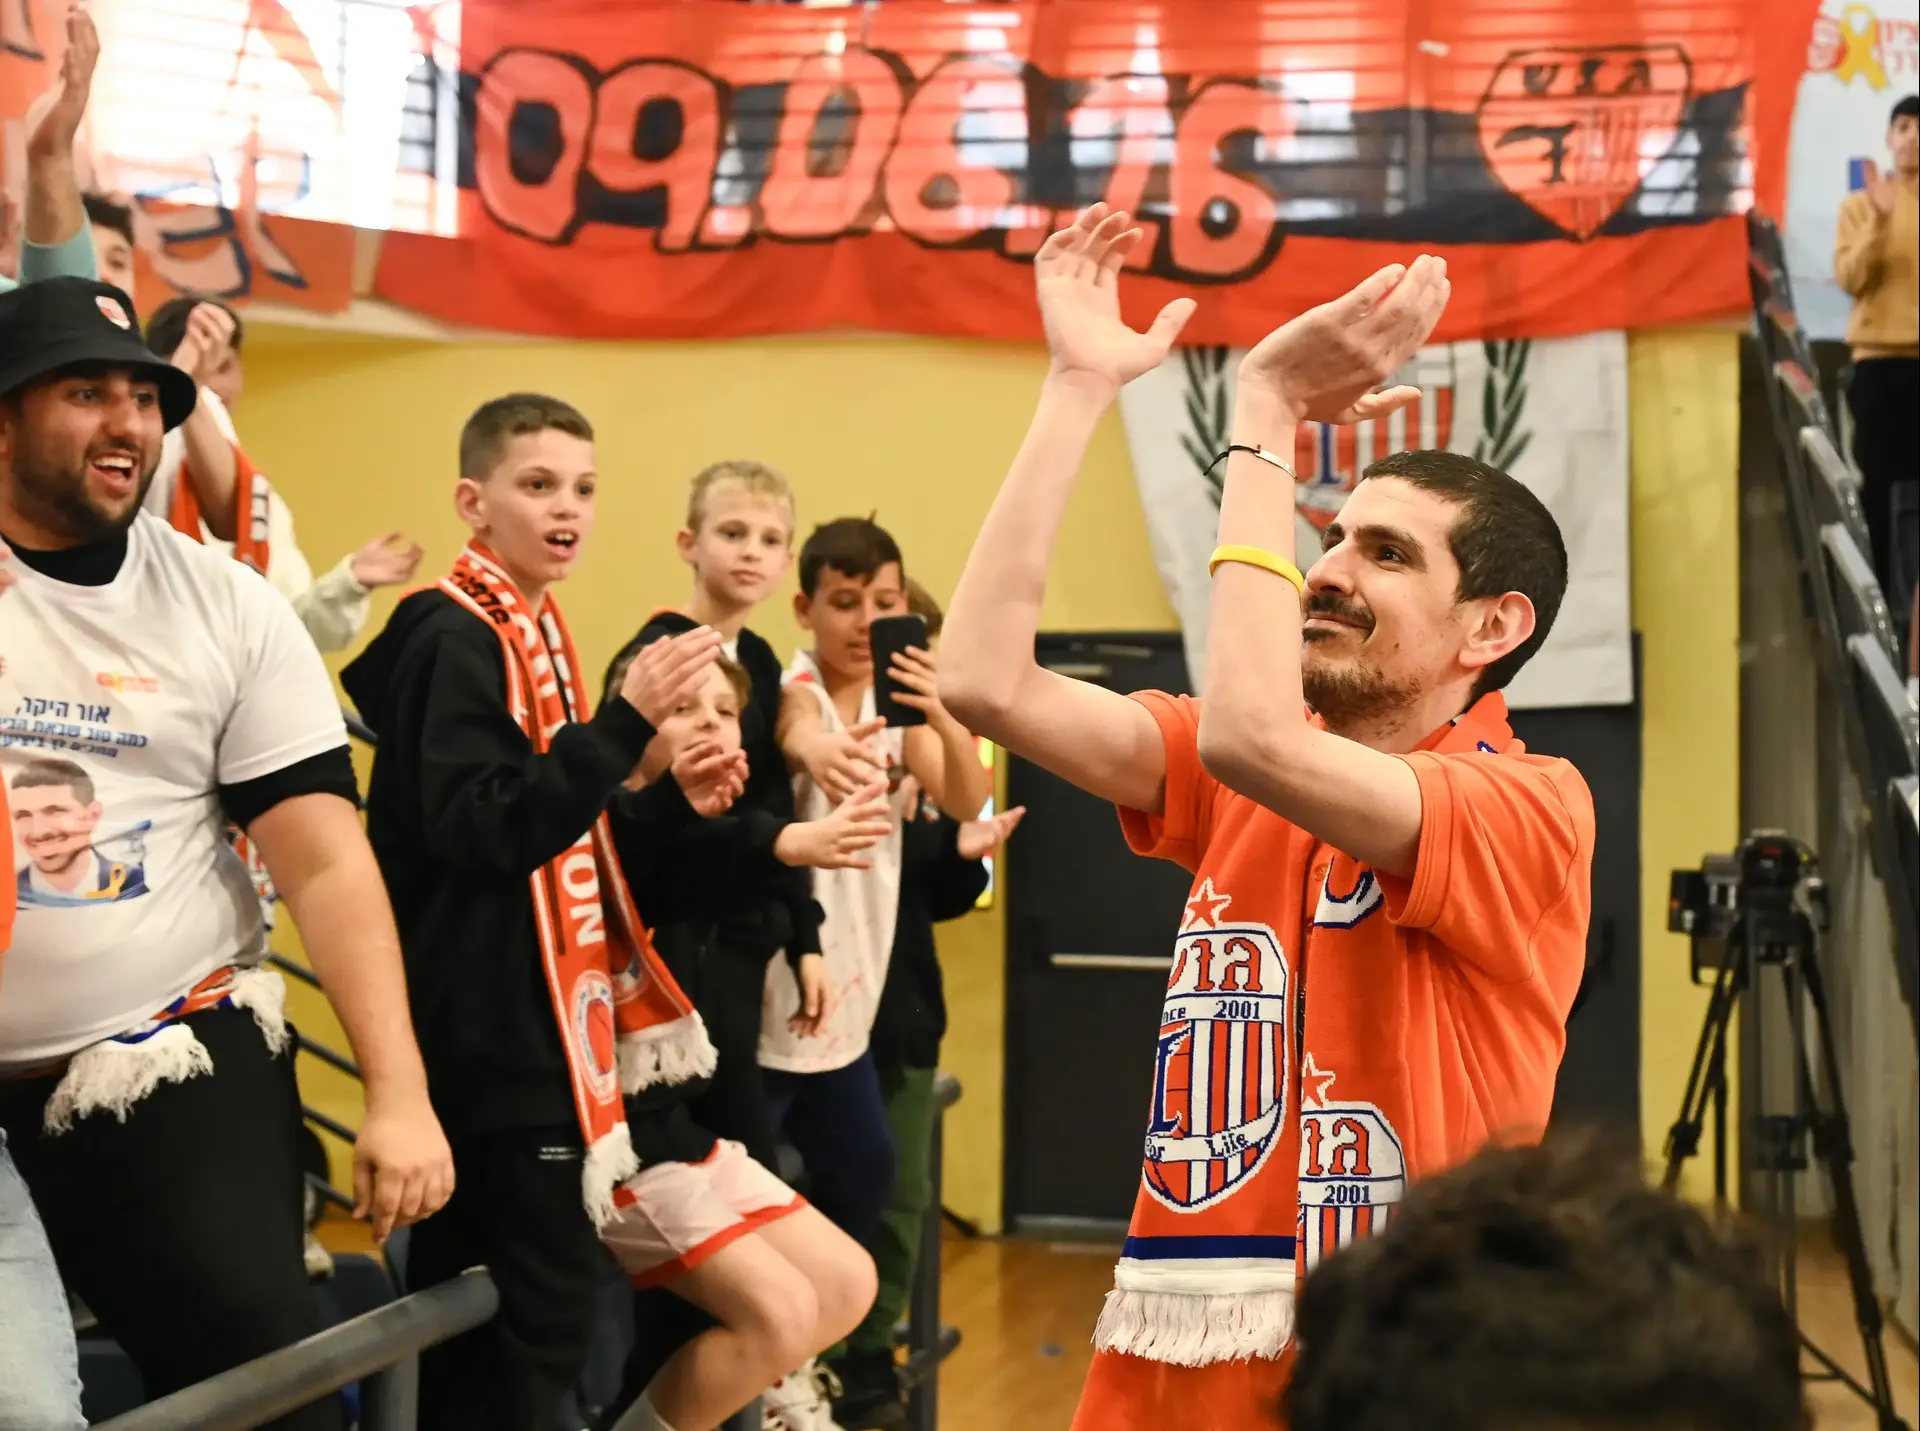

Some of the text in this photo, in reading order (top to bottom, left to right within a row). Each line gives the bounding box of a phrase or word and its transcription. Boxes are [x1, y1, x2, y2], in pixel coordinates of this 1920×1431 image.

[15, 696, 111, 723] אור היקר,
[561, 831, 606, 948] ON
[1162, 1000, 1260, 1022] nce 2001
[1322, 1185, 1371, 1204] 2001
